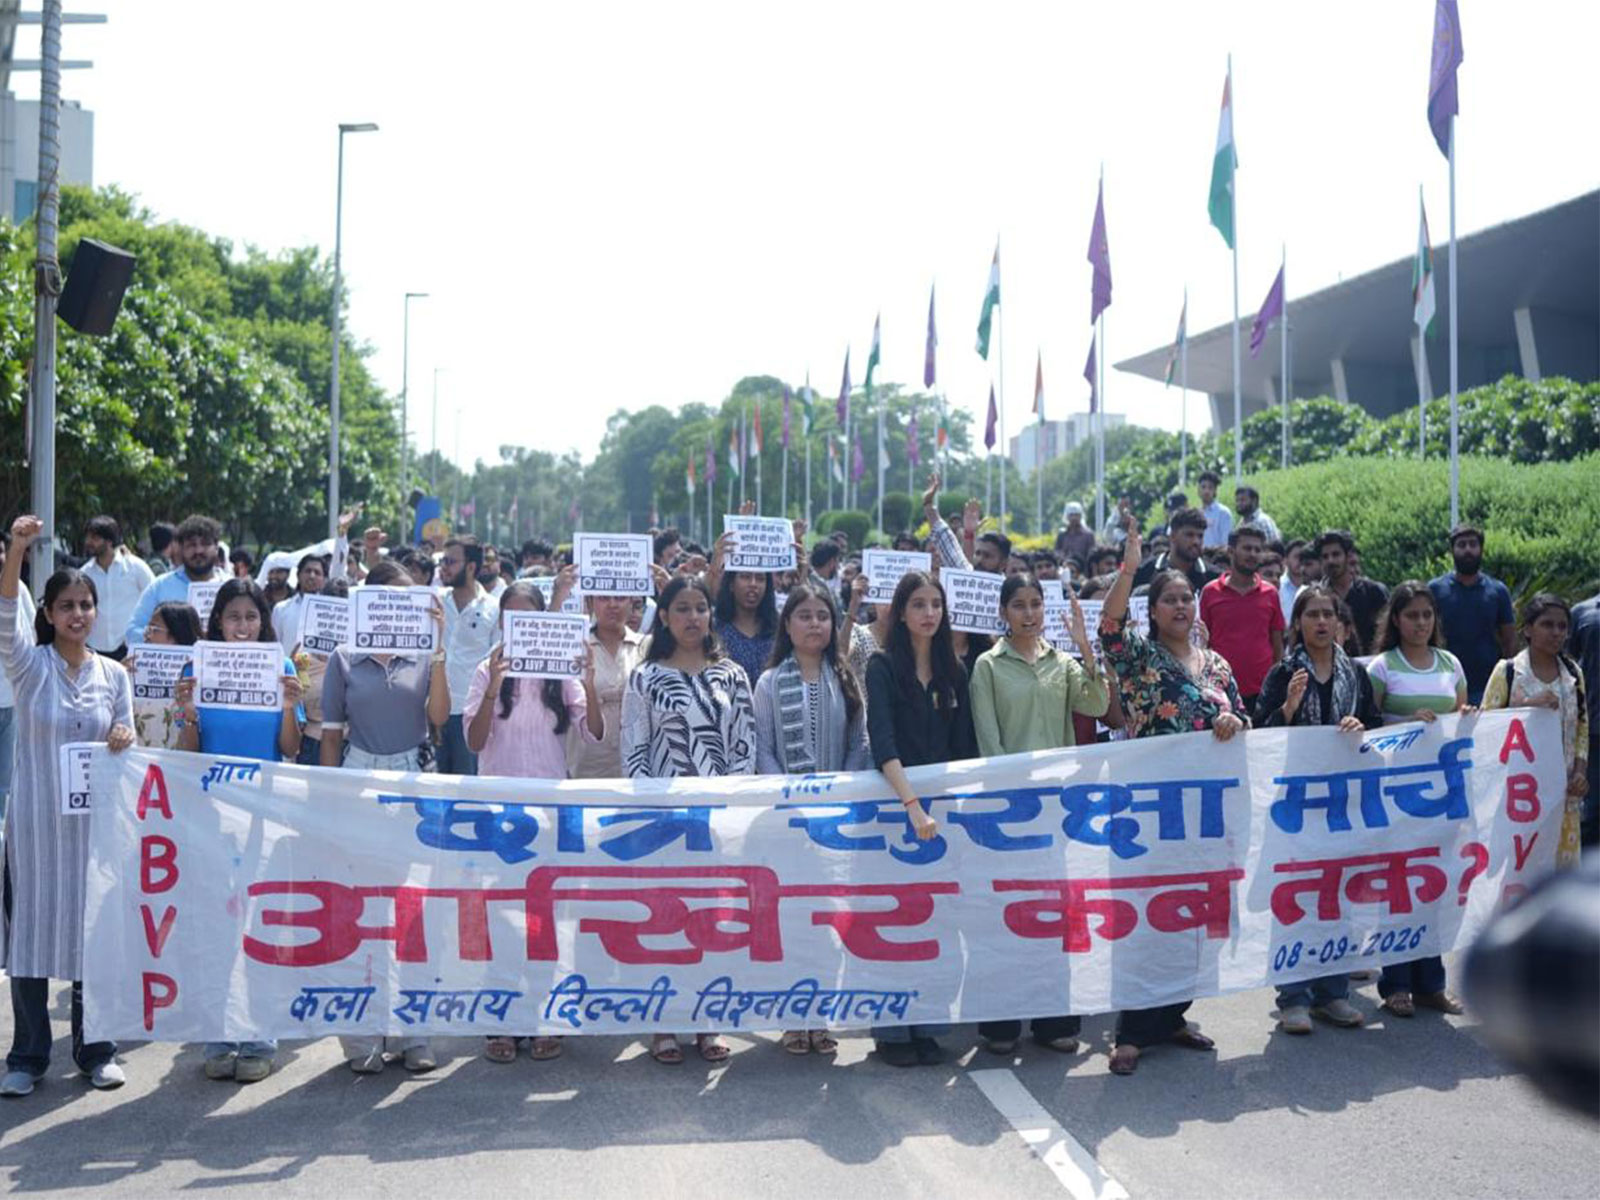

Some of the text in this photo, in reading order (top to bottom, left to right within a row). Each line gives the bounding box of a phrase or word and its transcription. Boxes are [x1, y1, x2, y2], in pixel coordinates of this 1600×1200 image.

[595, 578, 635, 590] ABVP DELHI
[956, 613, 973, 624] ABVP
[372, 633, 417, 648] ABVP DELHI
[524, 658, 567, 673] ABVP DELHI
[216, 690, 262, 705] ABVP DELHI
[201, 762, 261, 791] ज्ञान
[378, 737, 1474, 865] छात्र सुरक्षा मार्च
[243, 866, 959, 967] आखिर
[993, 868, 1245, 953] कब
[1274, 925, 1427, 971] 08-09-2026
[290, 973, 918, 1028] कला संकाय दिल्ली विश्वविद्यालय
